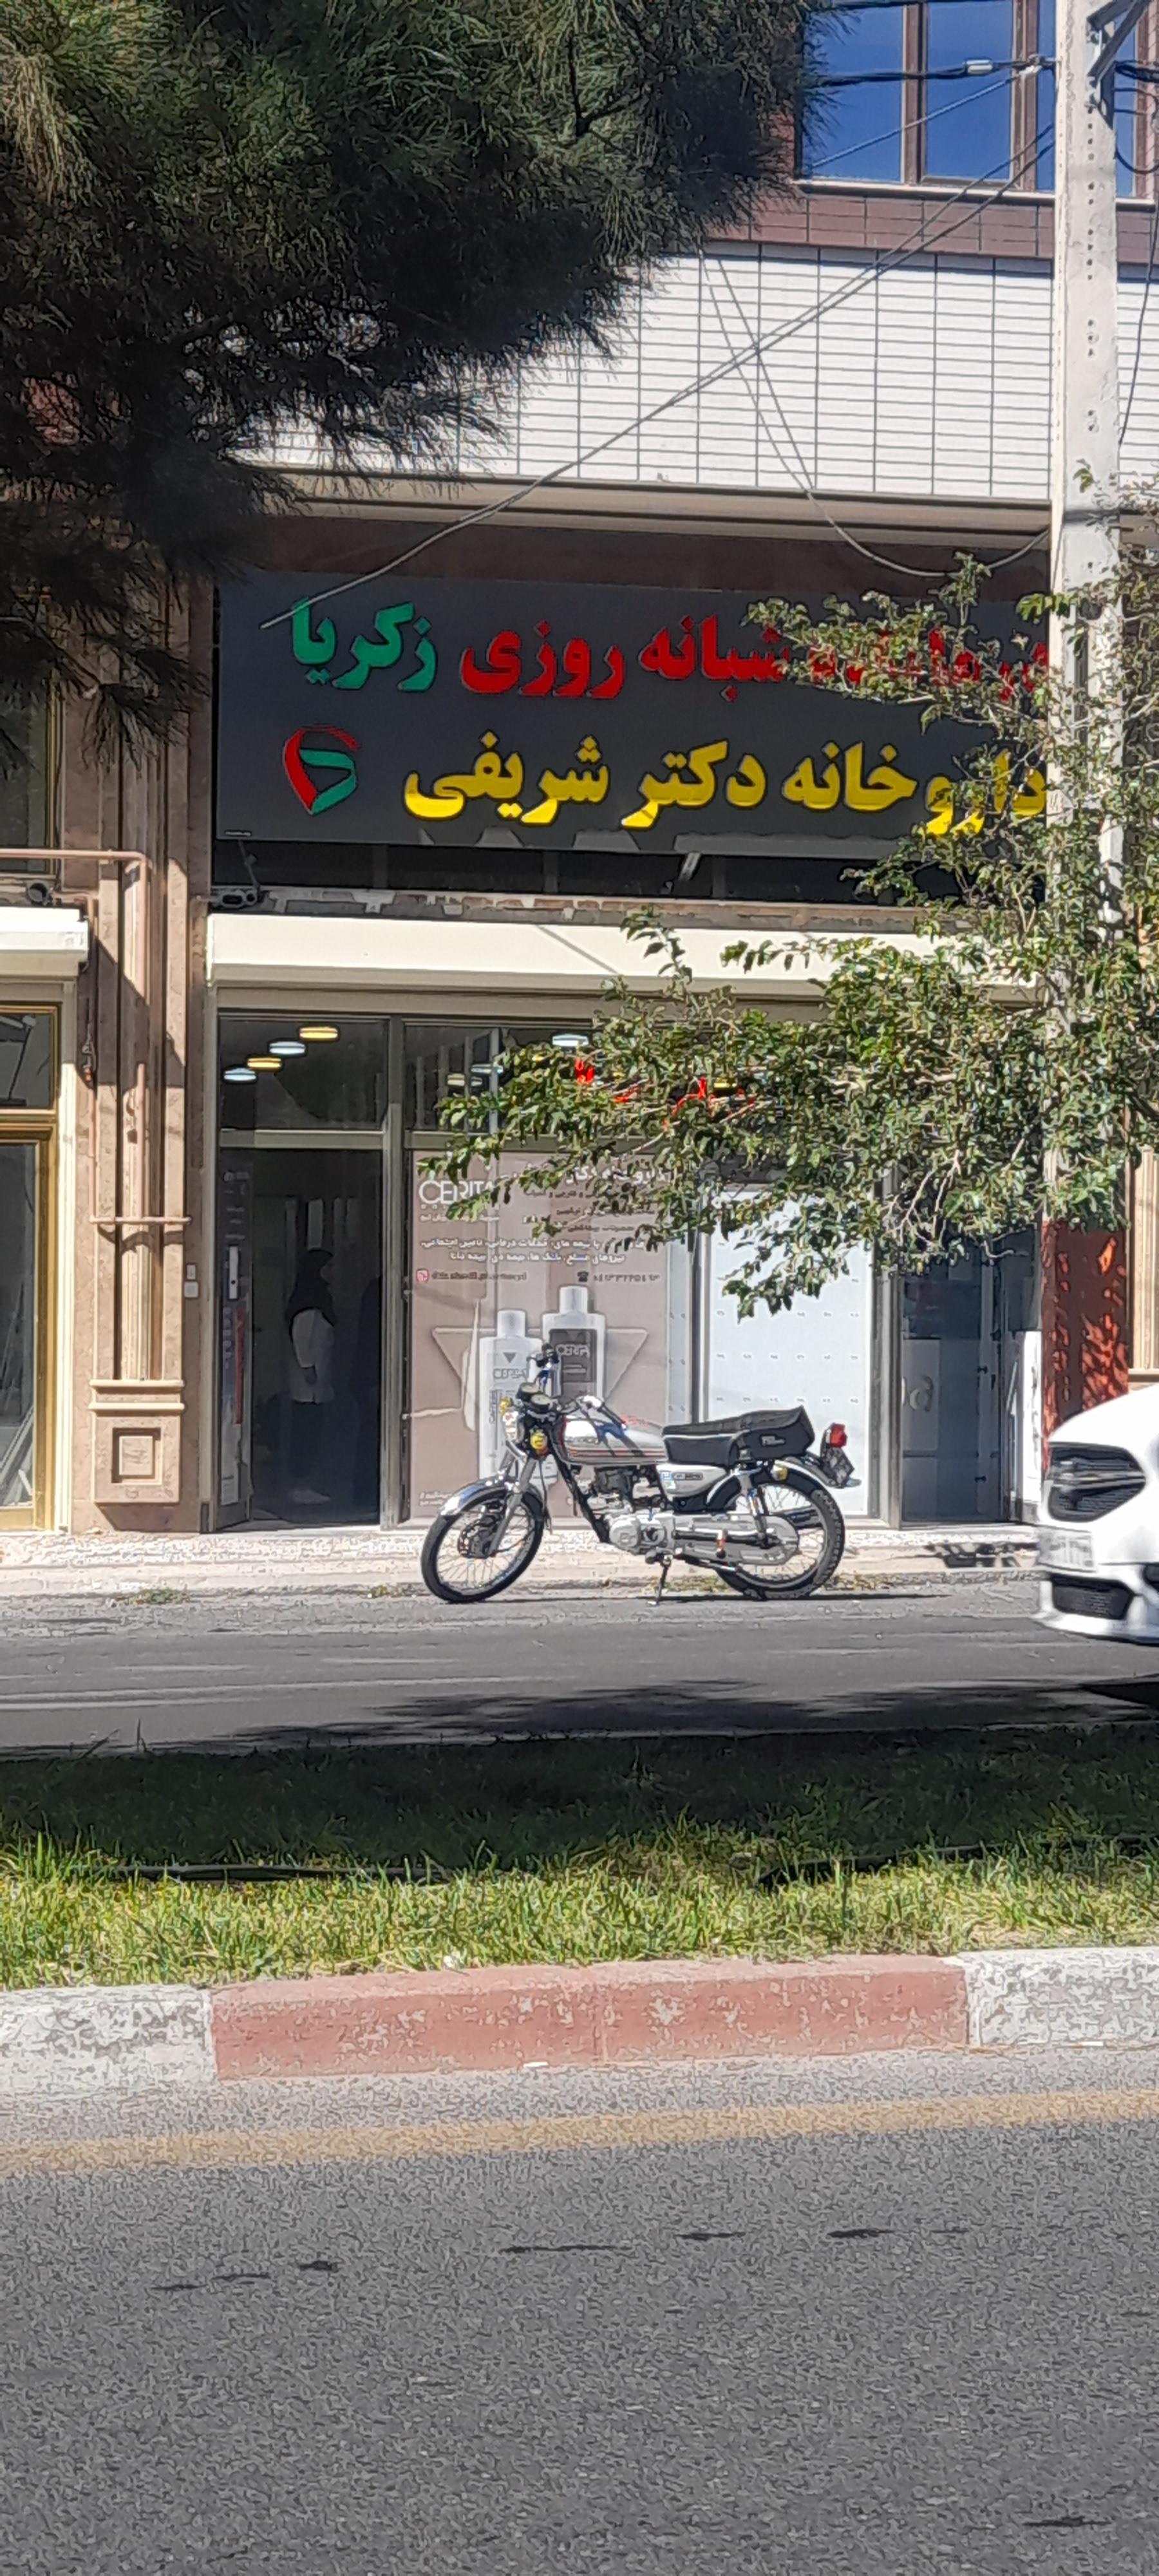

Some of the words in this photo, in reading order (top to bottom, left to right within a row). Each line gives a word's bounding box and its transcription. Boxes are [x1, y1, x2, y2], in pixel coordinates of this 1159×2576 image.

[291, 597, 437, 692] زکریا
[460, 620, 625, 698] روزی
[644, 614, 789, 702] شبانه
[404, 730, 609, 826] شریفی
[622, 741, 766, 830] دکتر
